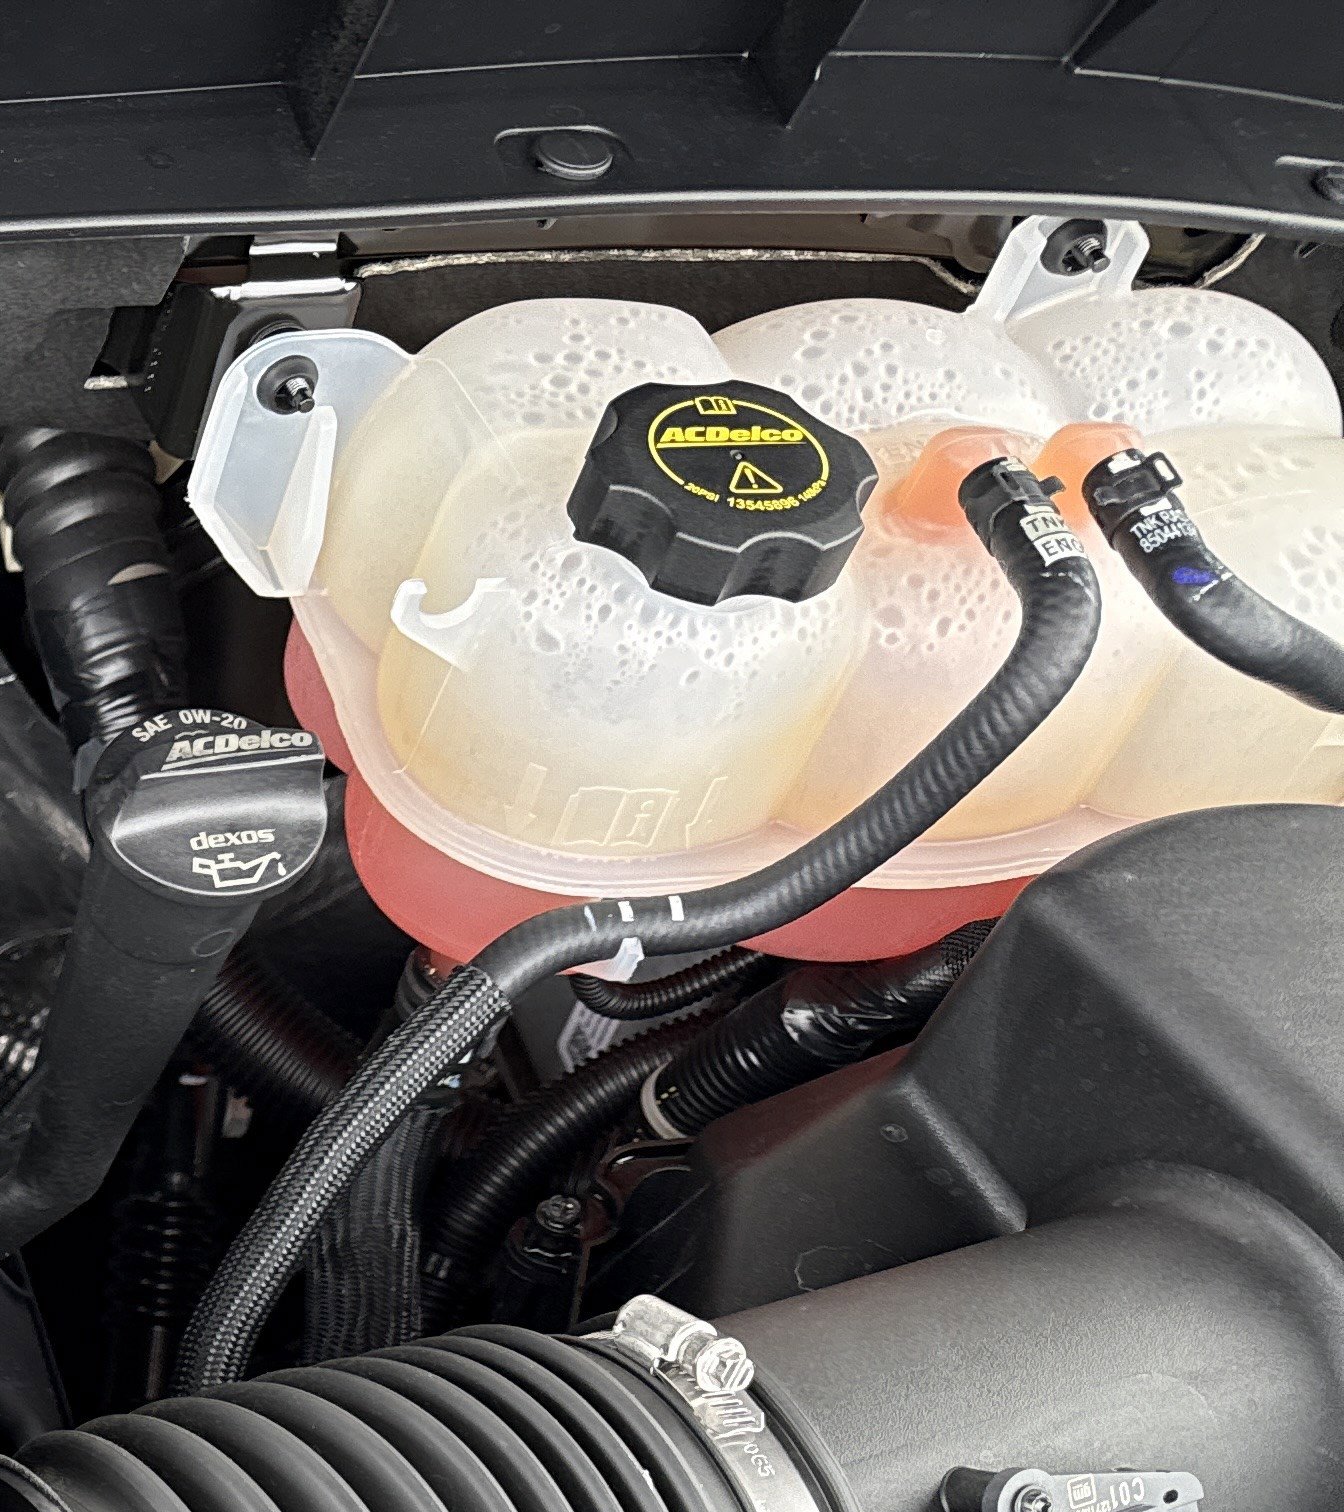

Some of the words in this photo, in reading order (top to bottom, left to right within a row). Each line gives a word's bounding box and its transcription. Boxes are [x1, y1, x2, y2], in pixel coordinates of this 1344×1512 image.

[659, 425, 804, 443] ACDelco
[131, 713, 174, 743] SAE
[178, 709, 248, 730] 0W-20
[164, 729, 313, 763] ACDelco
[189, 828, 276, 851] dexos
